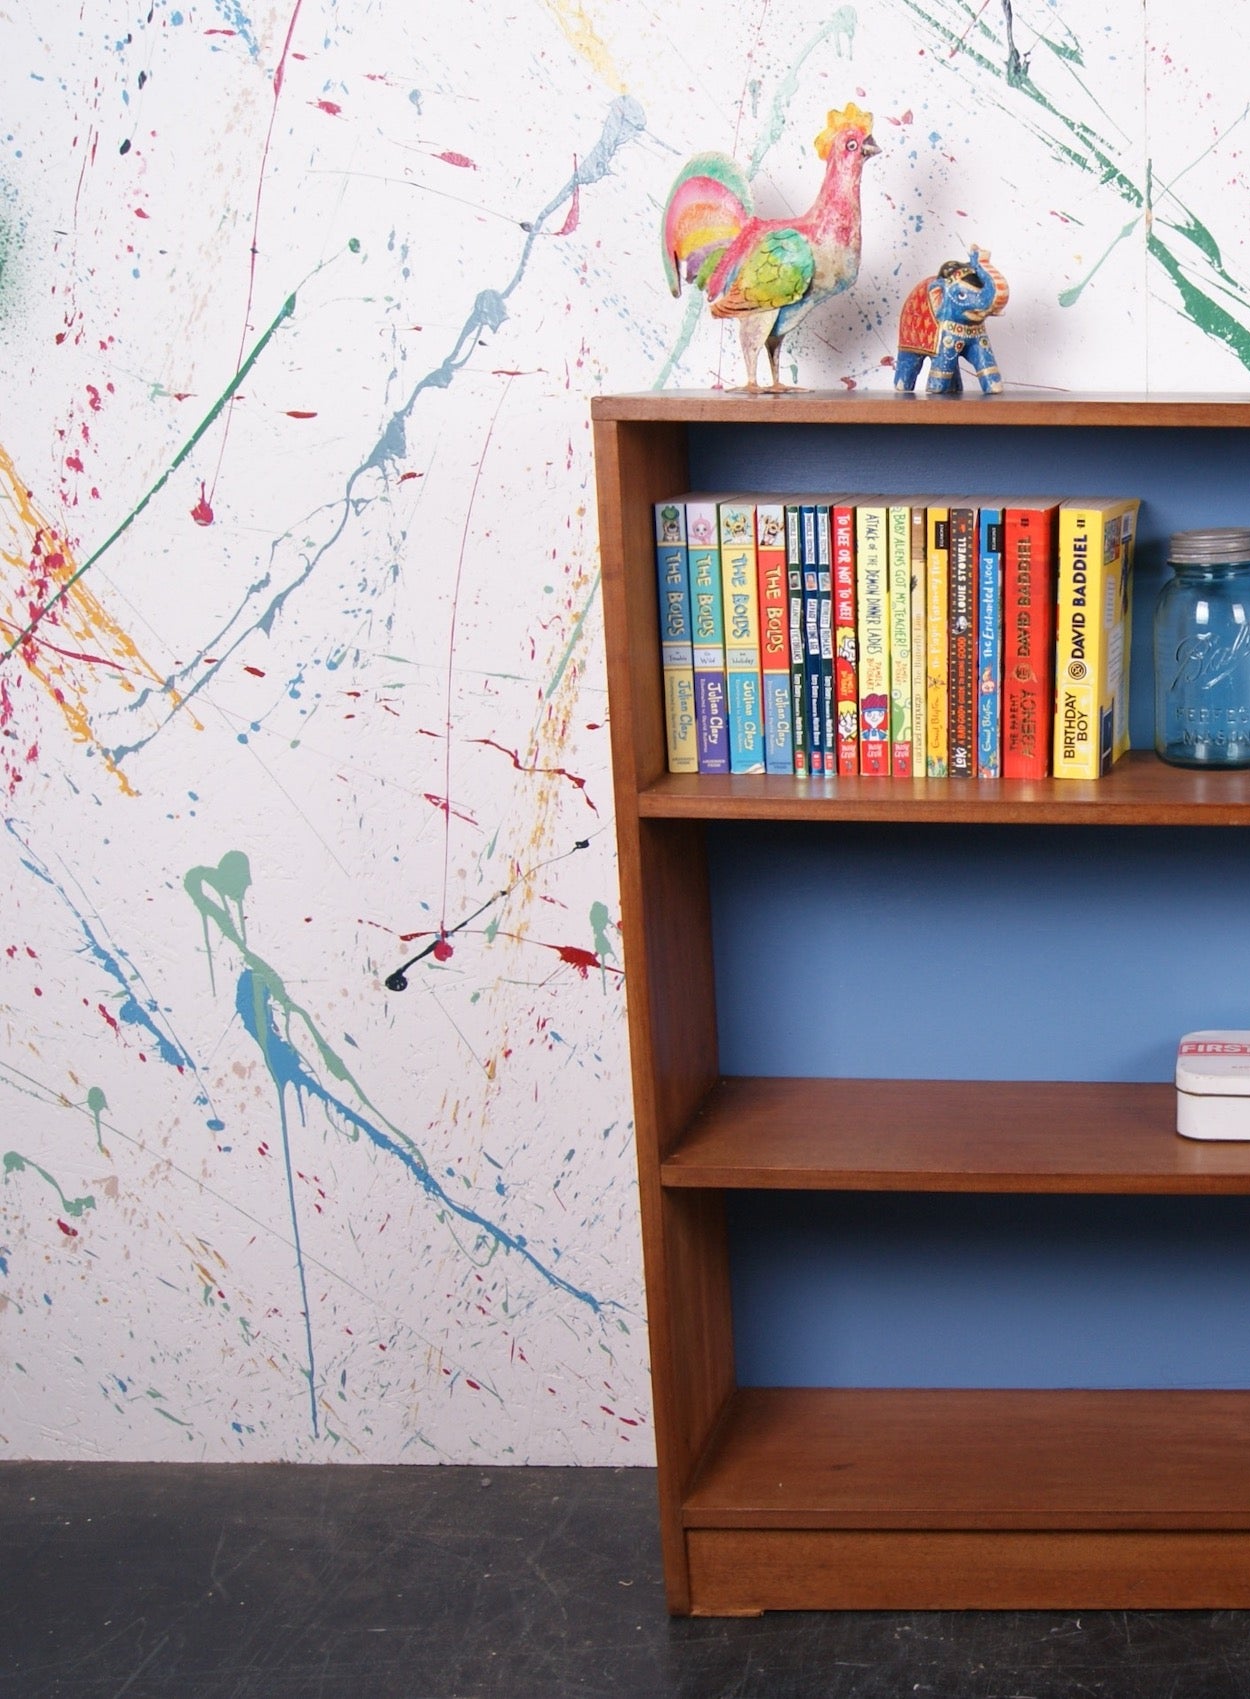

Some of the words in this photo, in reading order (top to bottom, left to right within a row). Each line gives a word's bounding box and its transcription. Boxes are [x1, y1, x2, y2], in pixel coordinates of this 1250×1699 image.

[837, 527, 851, 546] WEE
[865, 513, 880, 541] ATTACK
[893, 514, 906, 536] BABY
[837, 549, 851, 563] OR
[867, 555, 878, 566] THE
[893, 538, 906, 567] ALIENS
[957, 537, 967, 581] STOWELL
[665, 552, 682, 584] THE
[696, 554, 712, 587] THE
[731, 553, 748, 588] THE
[765, 564, 782, 600] THE
[838, 566, 852, 585] NOT
[865, 570, 880, 595] DEMON
[895, 571, 906, 588] GOT
[983, 558, 993, 584] Wood
[1017, 536, 1031, 607] BADDIEL
[1072, 534, 1087, 607] BADDIEL
[838, 600, 852, 620] WEE!
[865, 598, 880, 625] DINNER
[895, 593, 906, 604] MY
[958, 584, 966, 613] LOUIE
[982, 587, 994, 640] Enchanted
[666, 591, 685, 637] BOLDS
[696, 593, 715, 638] BOLDS
[732, 593, 750, 640] BOLDS
[894, 609, 907, 647] TEACHER!
[766, 607, 785, 653] BOLDS
[866, 628, 882, 655] LADIES
[1017, 612, 1030, 657] DAVID
[1071, 612, 1085, 660] DAVID
[914, 634, 922, 668] Butterfly
[957, 637, 966, 659] GOOD
[983, 641, 992, 658] The
[678, 680, 692, 711] Julian
[707, 682, 723, 714] Julian
[743, 680, 756, 716] Julian
[775, 688, 789, 719] Julian
[915, 694, 923, 730] morpurgo
[931, 697, 940, 725] Blyton
[982, 699, 992, 727] Blyton
[1010, 693, 1018, 730] PARENT
[1020, 689, 1036, 758] AGENCY
[1064, 692, 1076, 759] BIRTHDAY
[1077, 710, 1088, 742] BOY
[679, 714, 693, 741] Clary
[708, 716, 724, 744] Clary
[744, 721, 757, 751] Clary
[776, 721, 790, 748] Clary
[957, 724, 966, 739] BAD
[1010, 735, 1018, 750] THE
